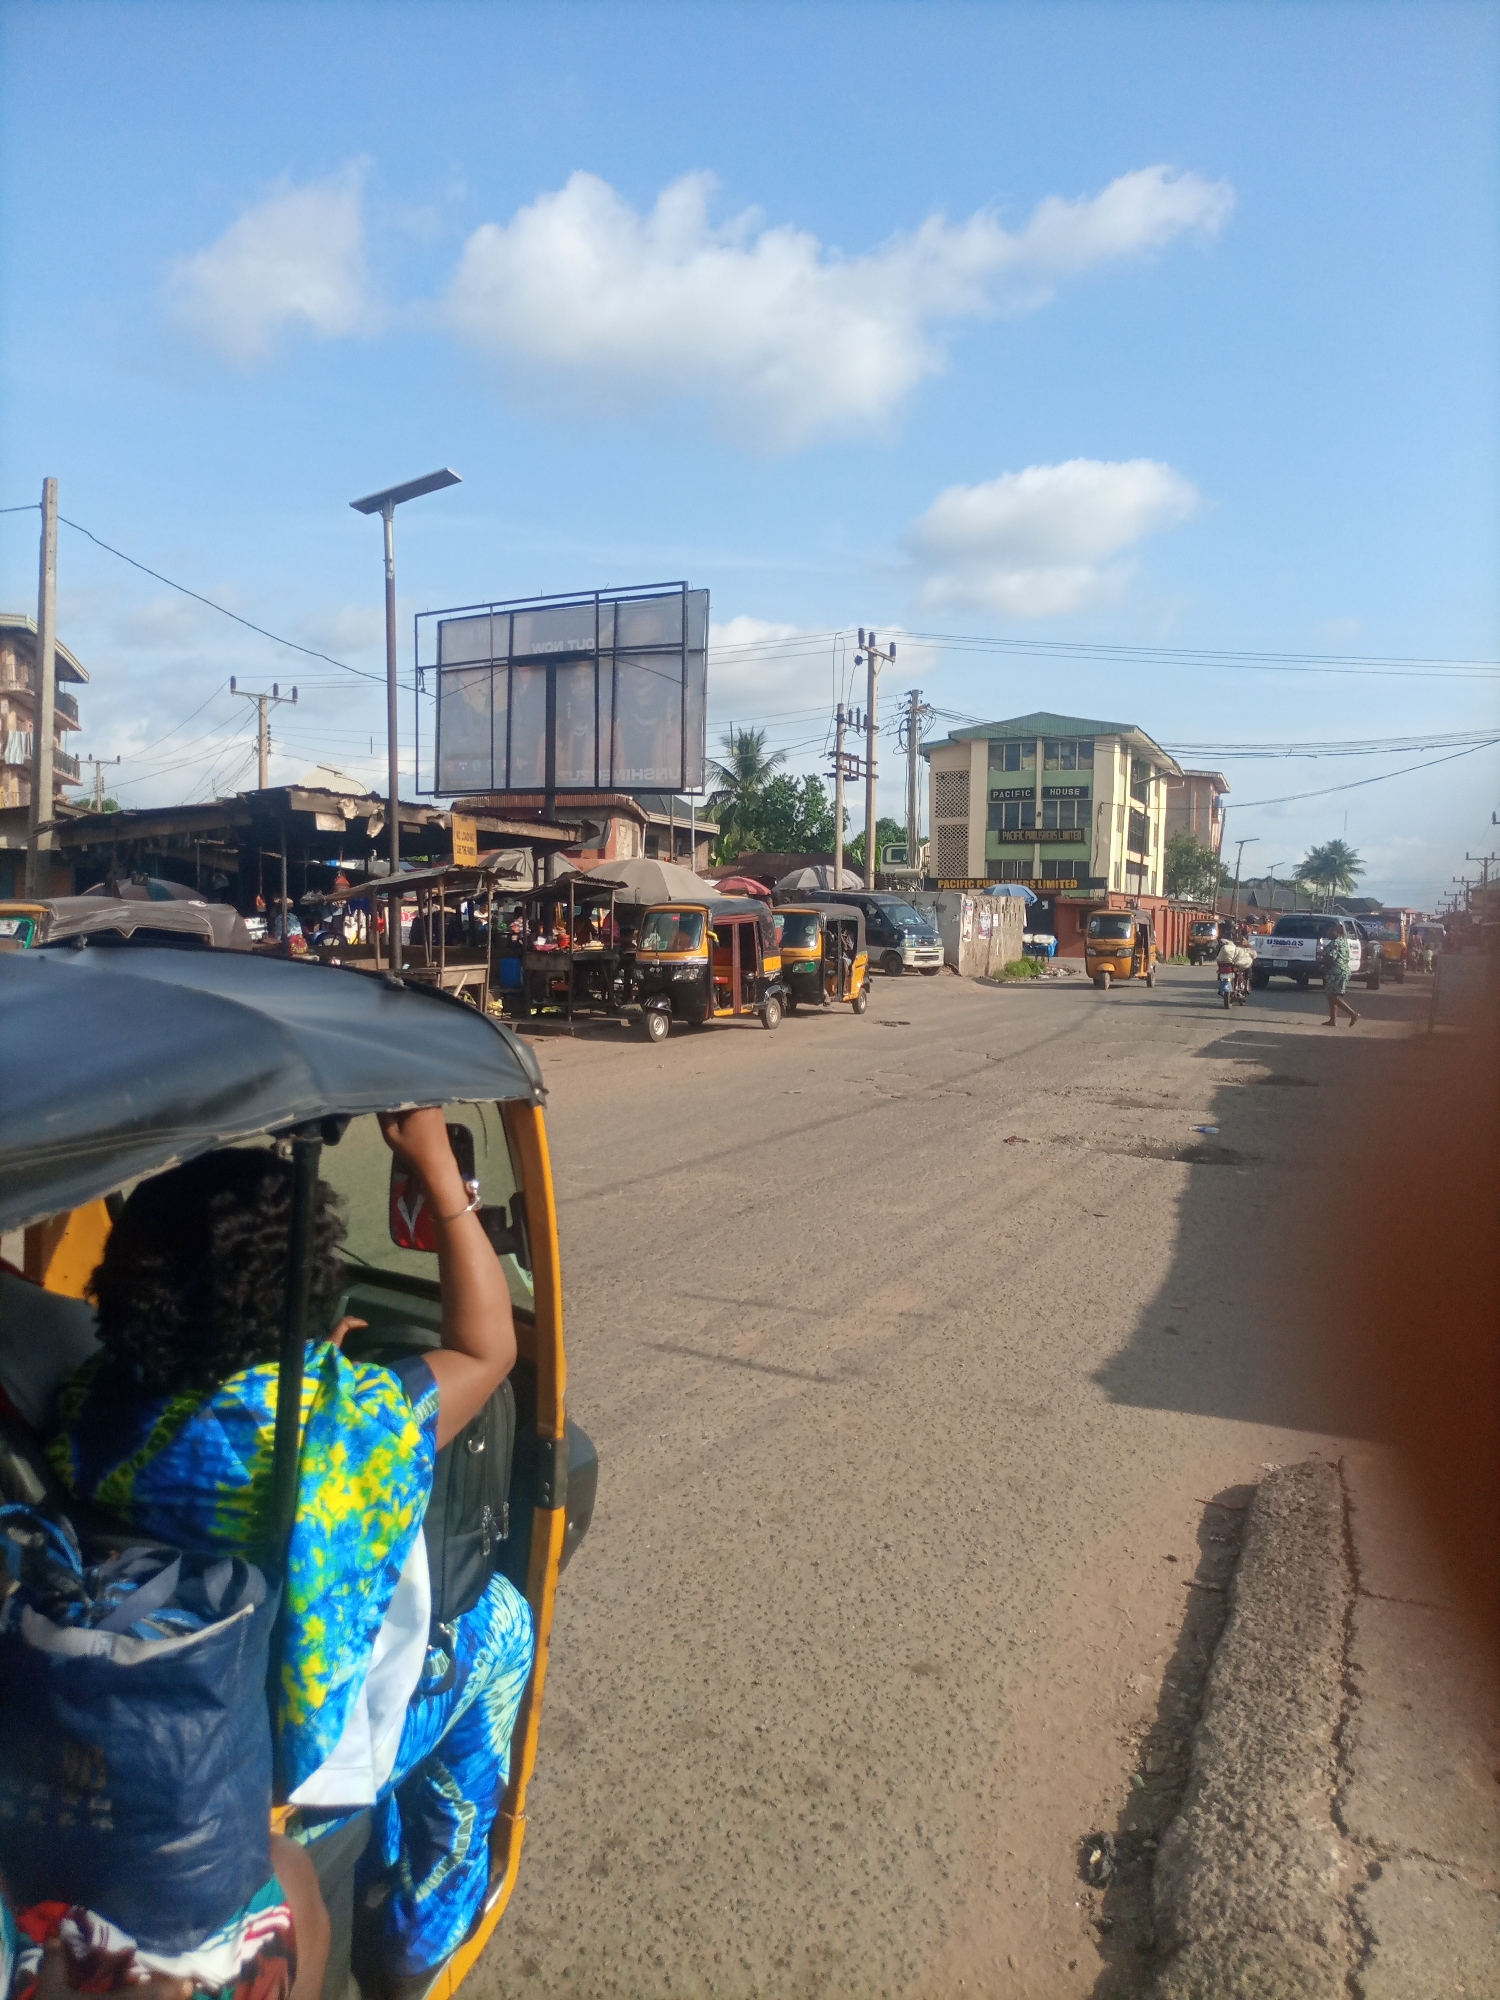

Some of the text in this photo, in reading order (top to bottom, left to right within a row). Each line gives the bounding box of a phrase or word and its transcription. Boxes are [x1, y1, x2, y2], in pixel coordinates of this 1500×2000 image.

[993, 788, 1080, 798] PACIFIC HOUSE
[1002, 831, 1024, 840] PACIFIC
[938, 880, 974, 889] PACIFIC
[1038, 879, 1078, 889] LIMITED
